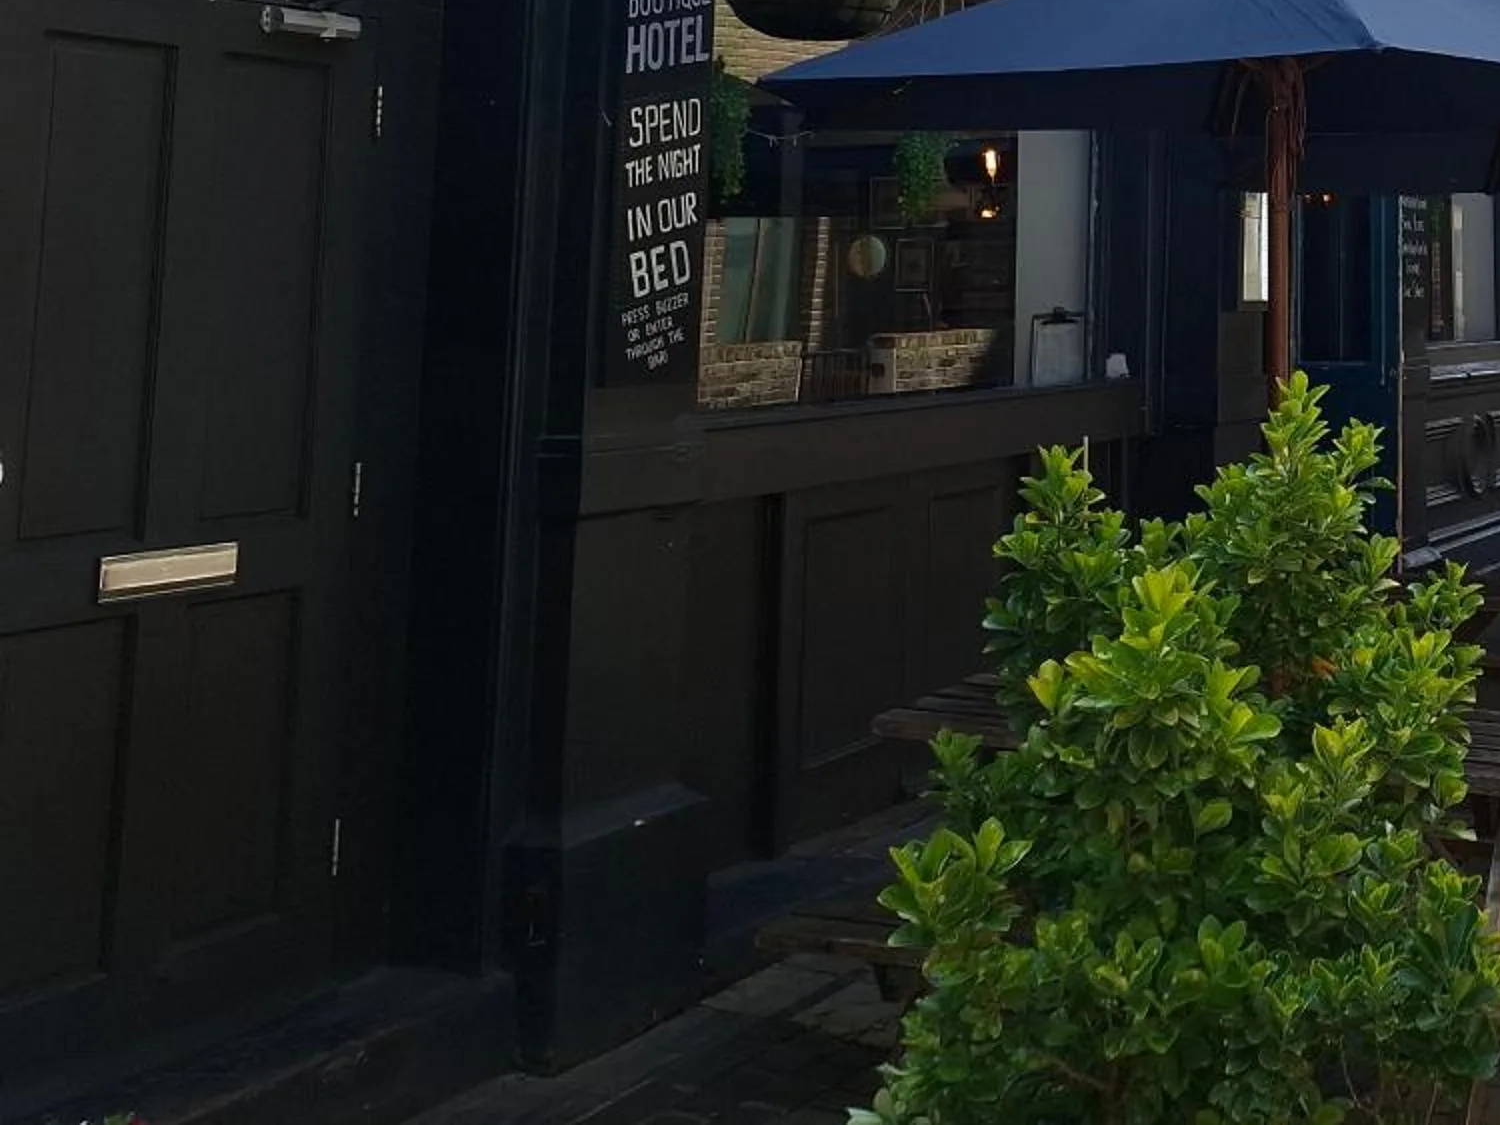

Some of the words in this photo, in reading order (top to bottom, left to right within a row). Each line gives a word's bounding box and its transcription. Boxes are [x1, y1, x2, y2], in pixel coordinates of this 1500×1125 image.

[625, 14, 710, 75] HOTEL
[629, 97, 702, 150] SPEND
[625, 156, 654, 189] THE
[657, 144, 703, 181] NIGHT
[627, 206, 654, 243] IN
[657, 192, 698, 236] OUR
[629, 240, 692, 300] BED
[621, 304, 650, 327] PRESS
[655, 292, 689, 316] BUZZER
[627, 328, 641, 342] OR
[645, 316, 674, 337] ENTER
[625, 336, 665, 361] THROUGH
